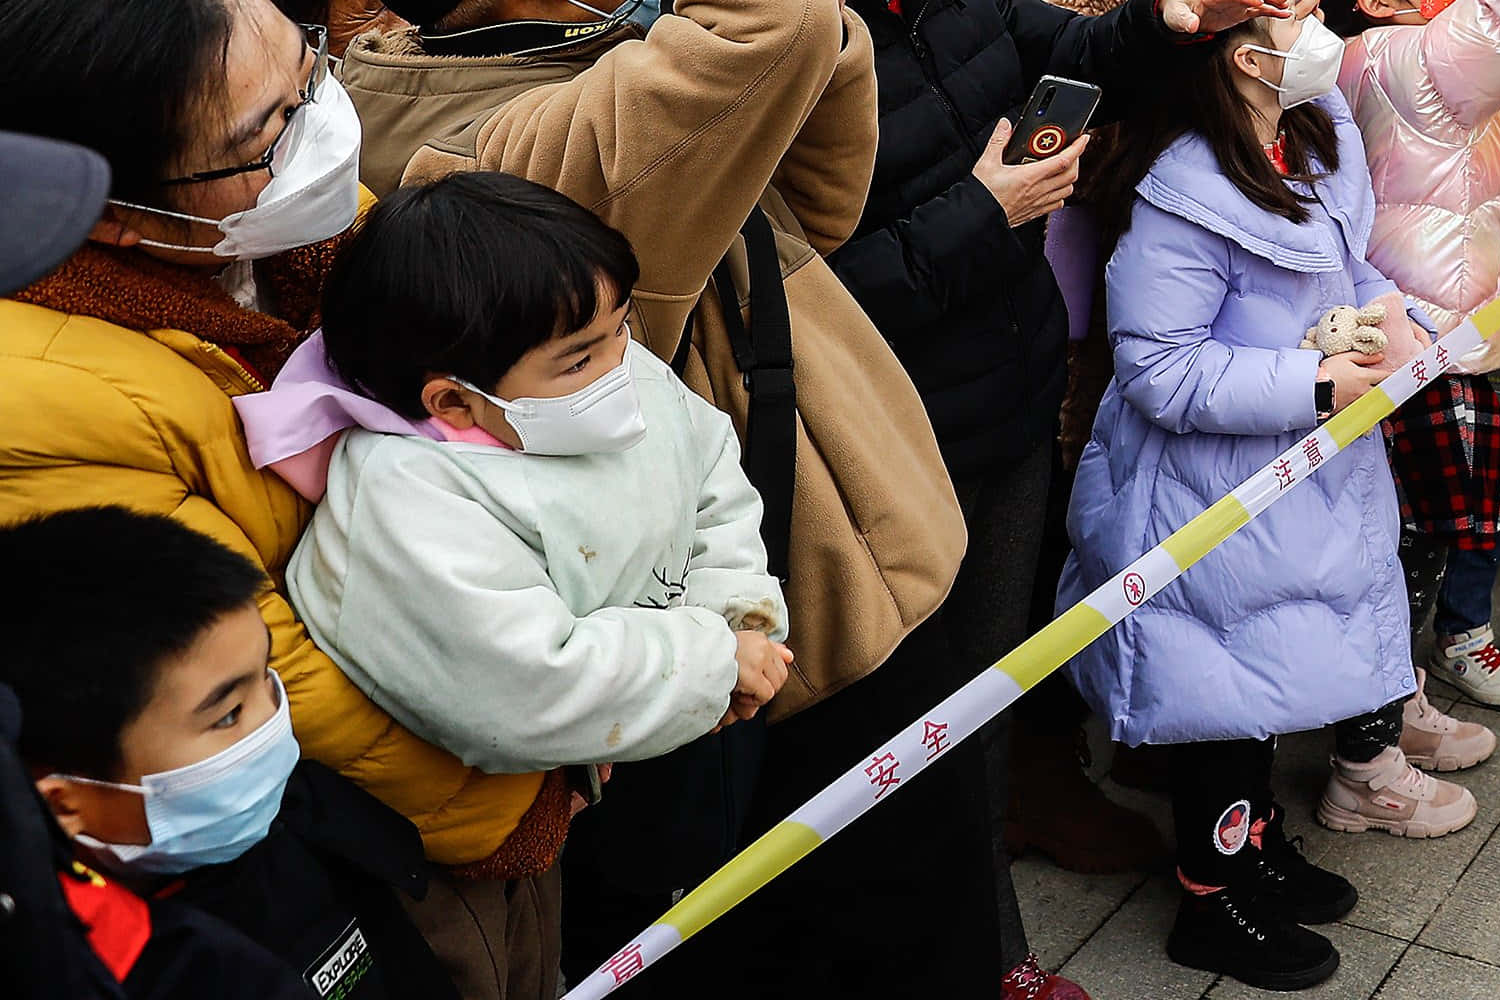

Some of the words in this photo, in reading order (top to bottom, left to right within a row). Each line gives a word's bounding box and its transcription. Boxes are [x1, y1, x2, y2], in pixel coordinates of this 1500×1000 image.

[864, 720, 951, 800] 安全
[1273, 436, 1324, 491] 注意
[1411, 345, 1450, 388] 安全
[319, 934, 365, 993] EXPLORE
